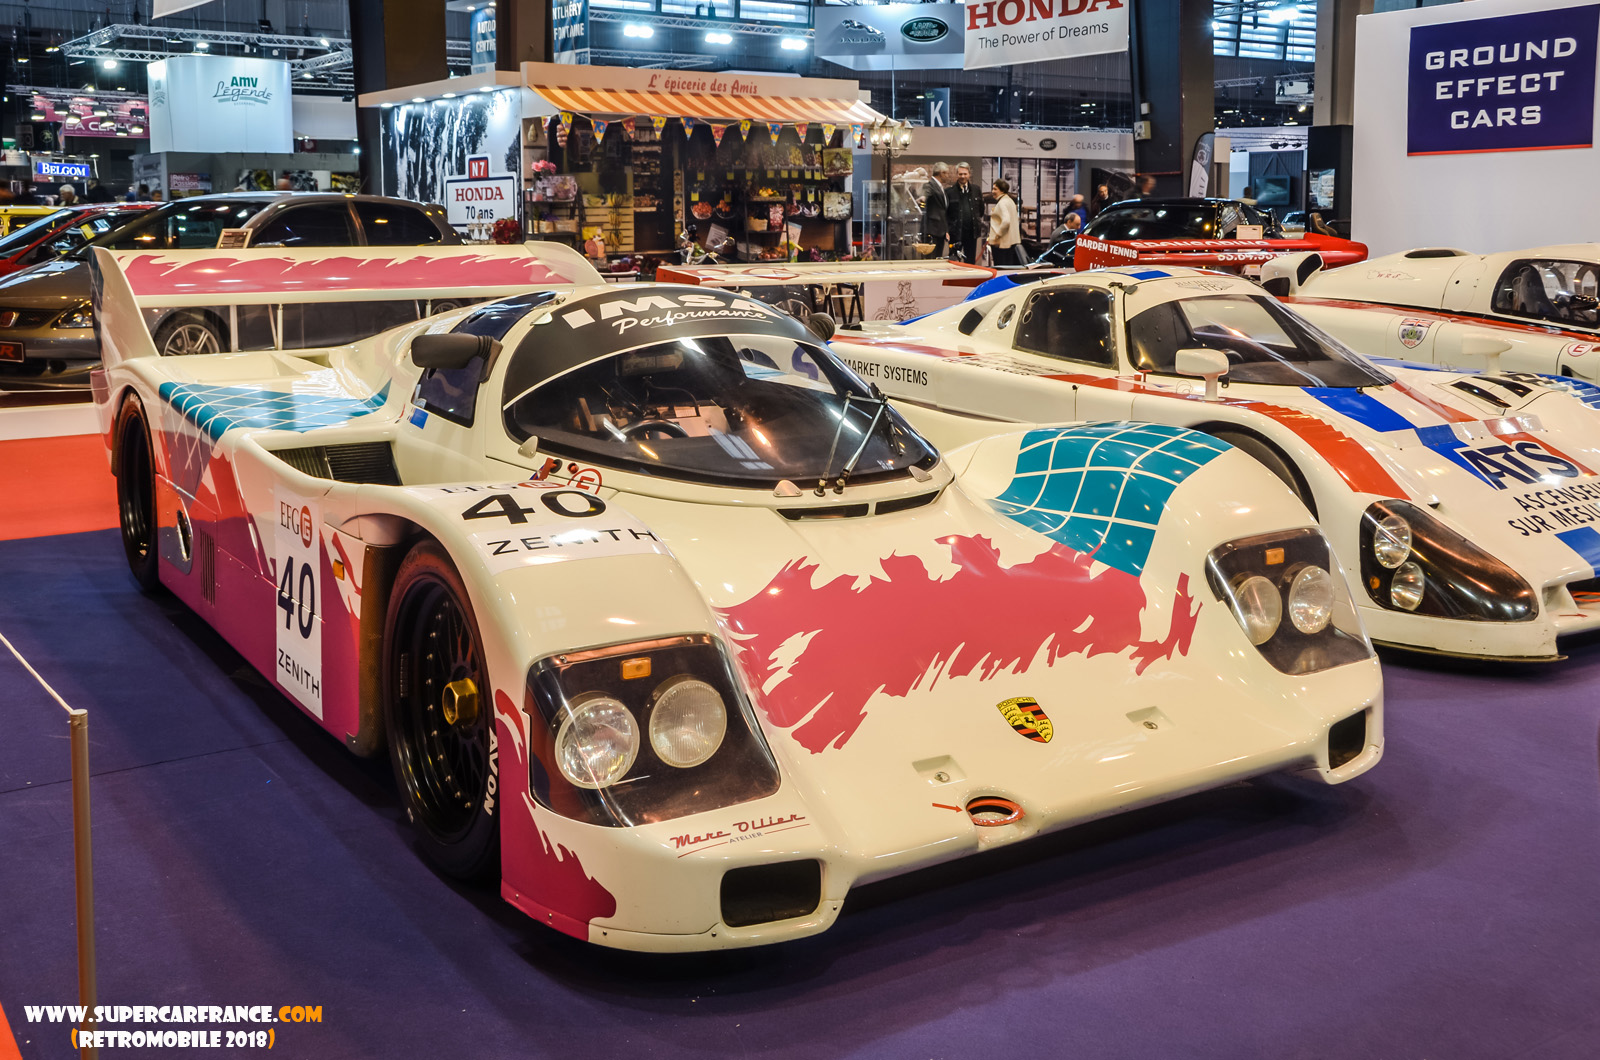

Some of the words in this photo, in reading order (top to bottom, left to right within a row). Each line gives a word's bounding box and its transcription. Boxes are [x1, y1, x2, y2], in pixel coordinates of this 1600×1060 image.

[978, 37, 999, 49] The
[1002, 33, 1040, 47] Power
[1042, 28, 1055, 41] of
[1059, 22, 1109, 39] Dreams
[1425, 37, 1577, 70] GROUND
[664, 76, 706, 92] épicerie
[710, 78, 727, 92] des
[731, 79, 758, 95] Amis
[1435, 70, 1565, 100] EFFECT
[1450, 105, 1542, 130] CARS
[1076, 142, 1111, 151] CLASSIC
[42, 163, 86, 176] BELGOM
[455, 187, 504, 202] HONDA
[465, 206, 475, 220] 70
[479, 208, 494, 220] ans
[1076, 237, 1108, 252] GARDEN
[1109, 244, 1138, 259] TENNIS
[561, 294, 785, 329] IMSA
[612, 309, 767, 335] Performance
[884, 365, 928, 386] SYSTEMS
[1460, 442, 1579, 490] ATS
[280, 500, 300, 535] EFG
[461, 490, 607, 525] 40
[1508, 515, 1556, 536] SUR
[278, 555, 315, 639] 40
[278, 648, 319, 699] ZENITH
[484, 726, 498, 816] AVON
[670, 831, 731, 849] Marc
[733, 814, 806, 832] Ollier
[729, 832, 763, 843] ATELIER
